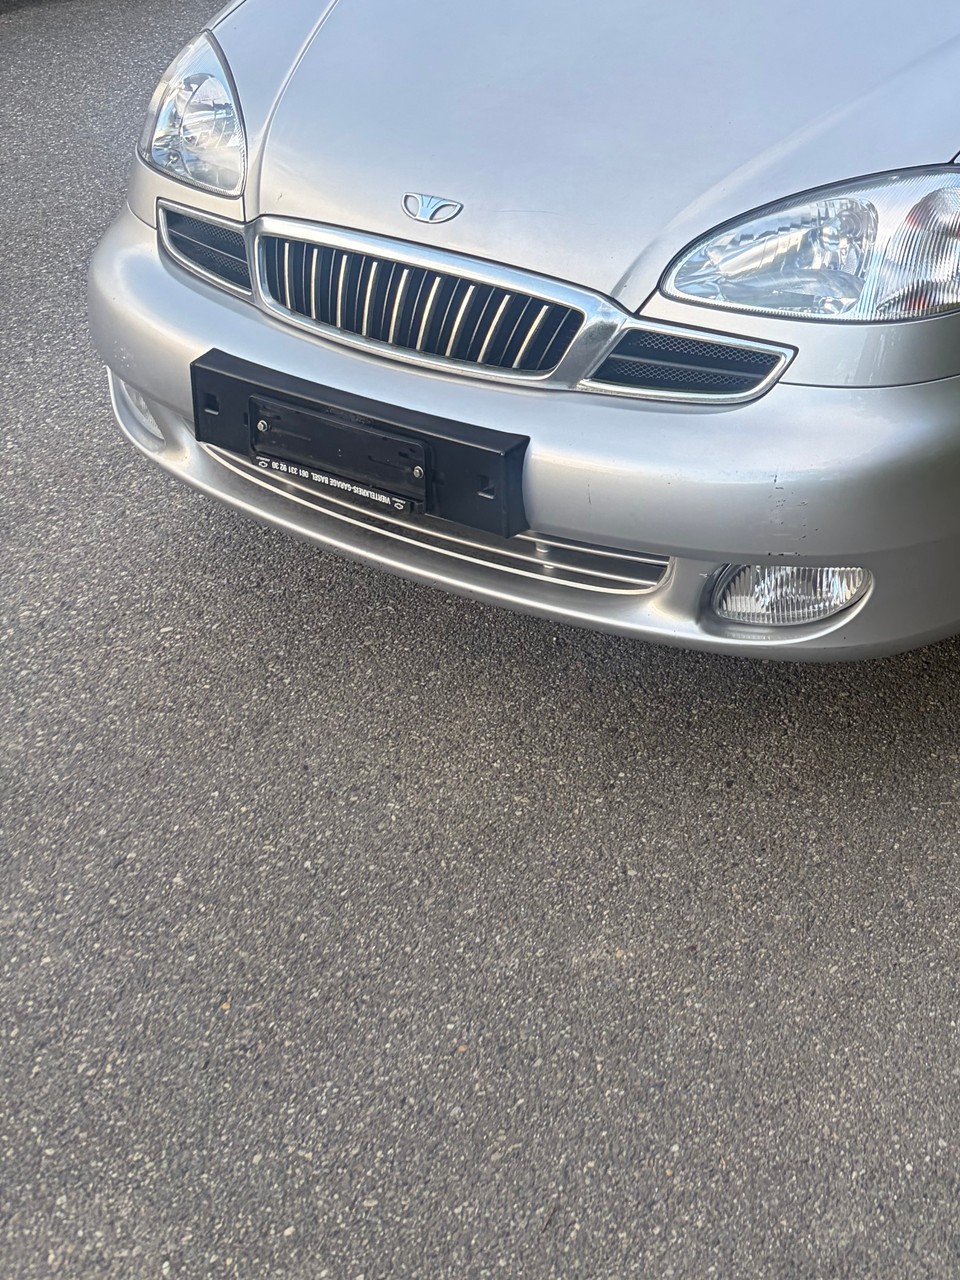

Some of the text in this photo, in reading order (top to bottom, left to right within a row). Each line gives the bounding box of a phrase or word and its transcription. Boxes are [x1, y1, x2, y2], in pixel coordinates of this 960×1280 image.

[288, 465, 298, 475] 331
[299, 468, 309, 478] 061
[311, 472, 329, 485] BASEL
[329, 477, 391, 505] VIERTELKREIS-GARAGE
